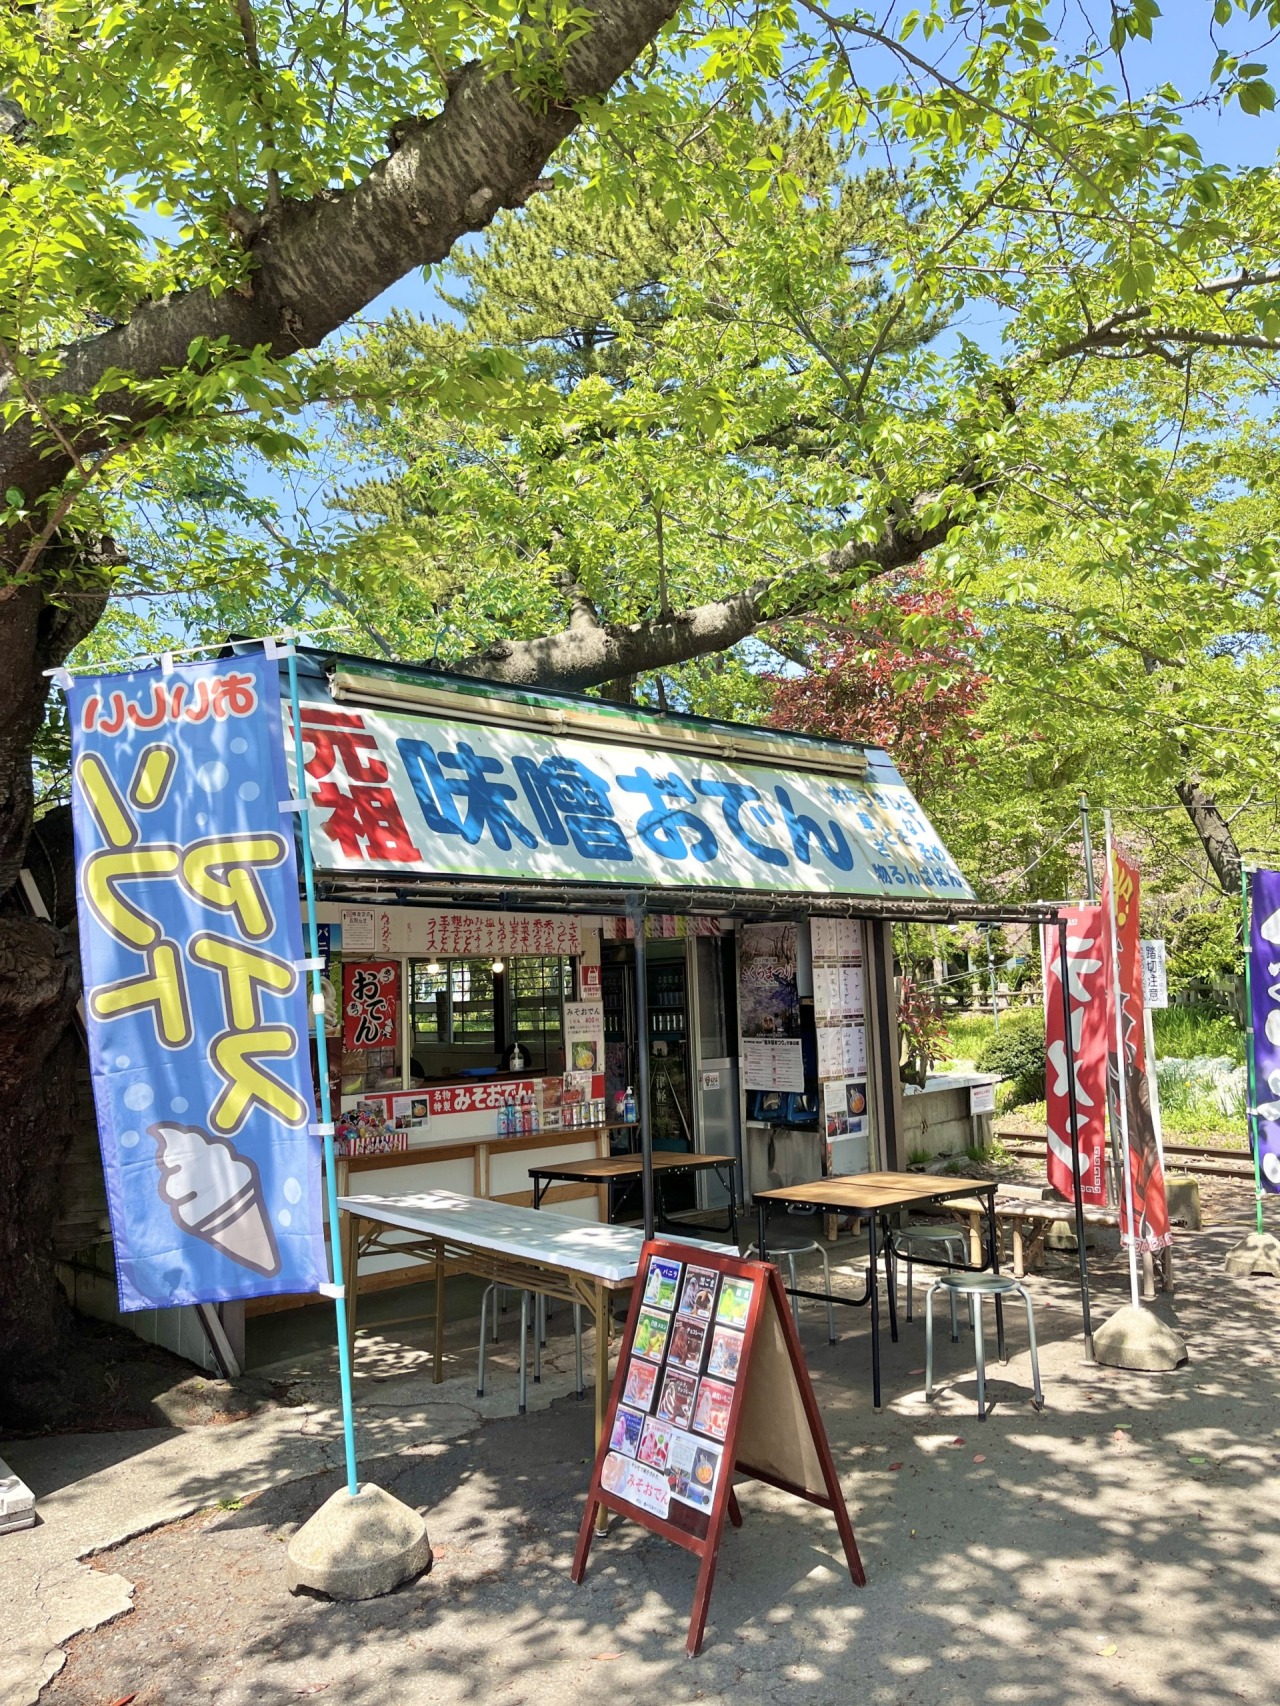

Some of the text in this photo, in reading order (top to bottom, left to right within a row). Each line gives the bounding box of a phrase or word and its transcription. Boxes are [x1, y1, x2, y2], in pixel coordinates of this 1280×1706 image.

[286, 702, 420, 863] 元祖
[395, 736, 854, 872] 味噌おでん
[426, 918, 438, 952] ライス
[450, 915, 463, 953] 親子どん
[463, 915, 475, 953] かつどん
[557, 922, 567, 953] うどん
[742, 962, 794, 981] さくらまつり
[1145, 945, 1159, 1002] 踏切注意
[352, 969, 388, 1044] おでん
[566, 1007, 601, 1017] みそおでん
[433, 1090, 452, 1101] 名物
[433, 1102, 452, 1112] 特製
[453, 1082, 533, 1111] みそおでん
[662, 1268, 678, 1279] バニラ
[627, 1473, 669, 1506] みそおでん
